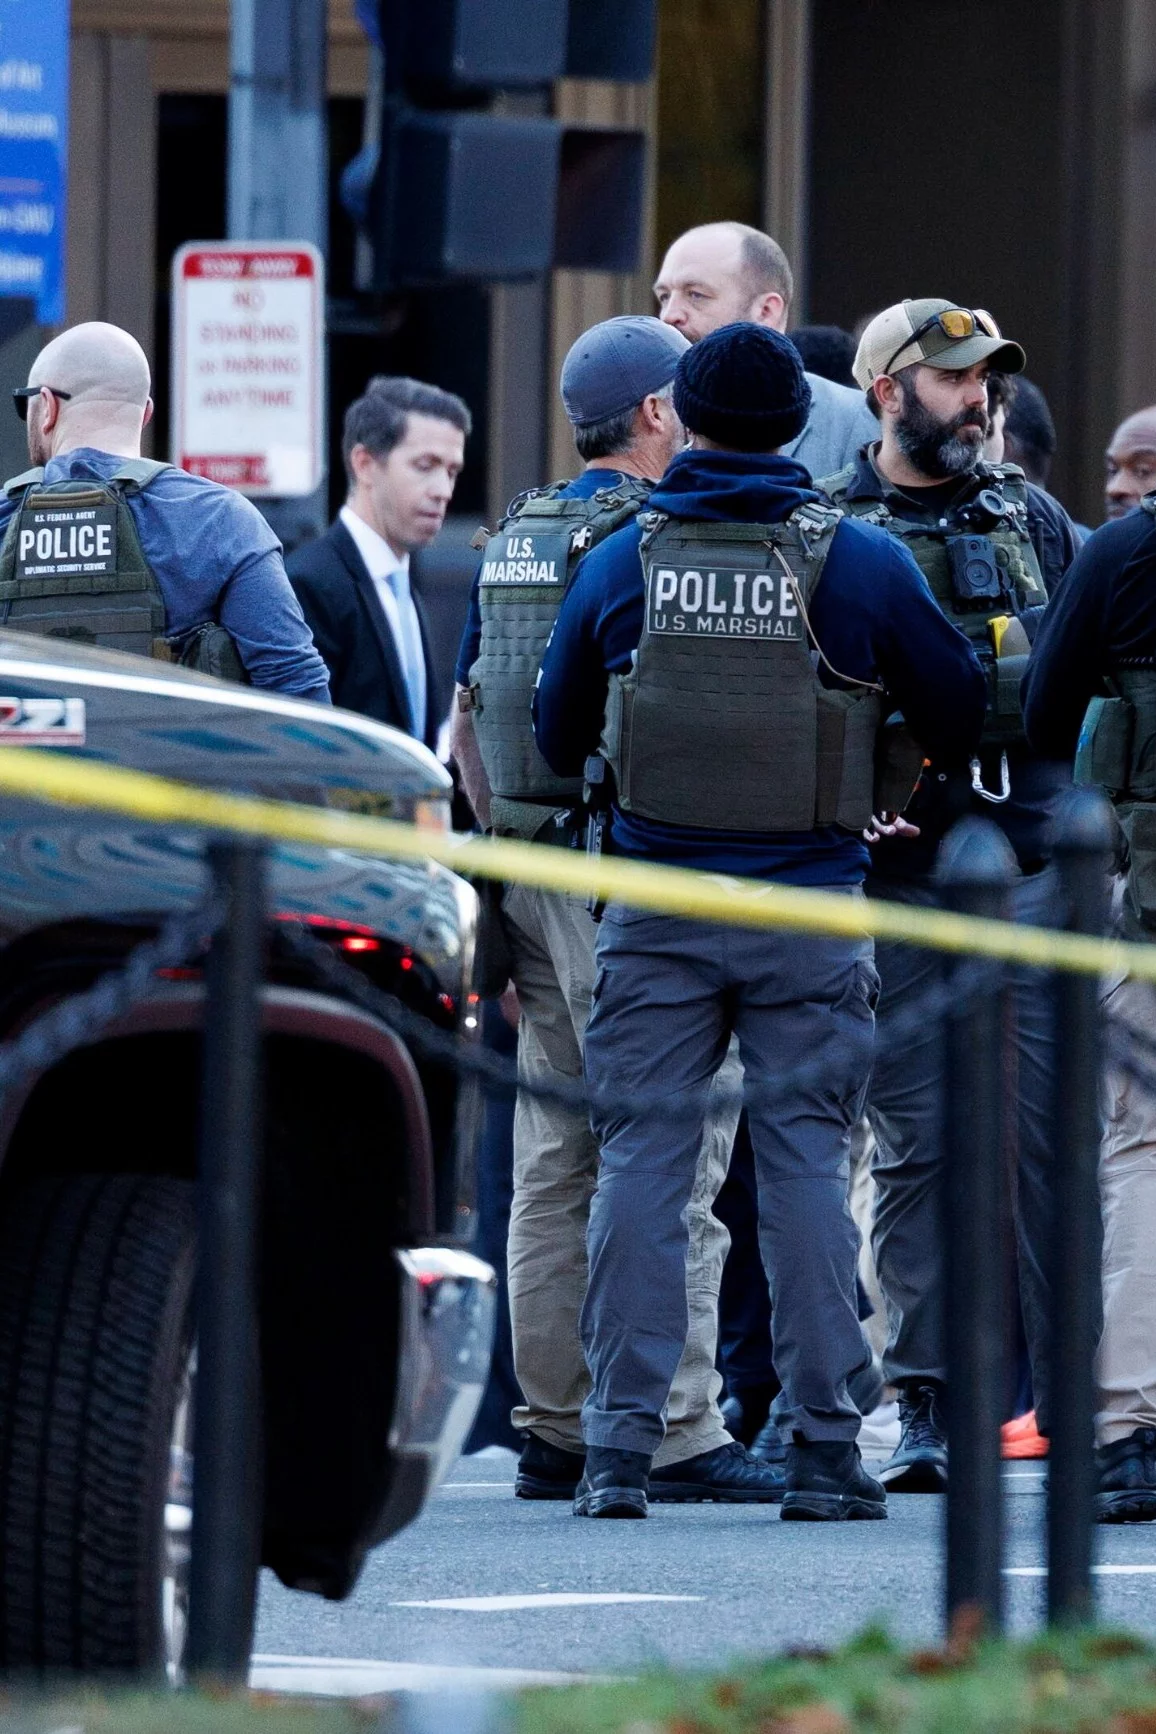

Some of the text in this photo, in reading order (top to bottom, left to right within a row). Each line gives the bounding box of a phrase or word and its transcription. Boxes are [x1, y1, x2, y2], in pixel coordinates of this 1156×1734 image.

[234, 289, 266, 311] NO
[200, 323, 299, 343] STANDING
[223, 355, 301, 374] PARKING
[46, 511, 75, 522] FEDERAL
[75, 510, 97, 520] AGENT
[20, 524, 112, 561] POLICE
[506, 537, 536, 559] U.S.
[56, 563, 83, 573] SECURITY
[83, 562, 107, 571] SERVICE
[481, 560, 559, 582] MARSHAL
[655, 569, 798, 617] POLICE
[654, 614, 797, 637] U.S. MARSHAL
